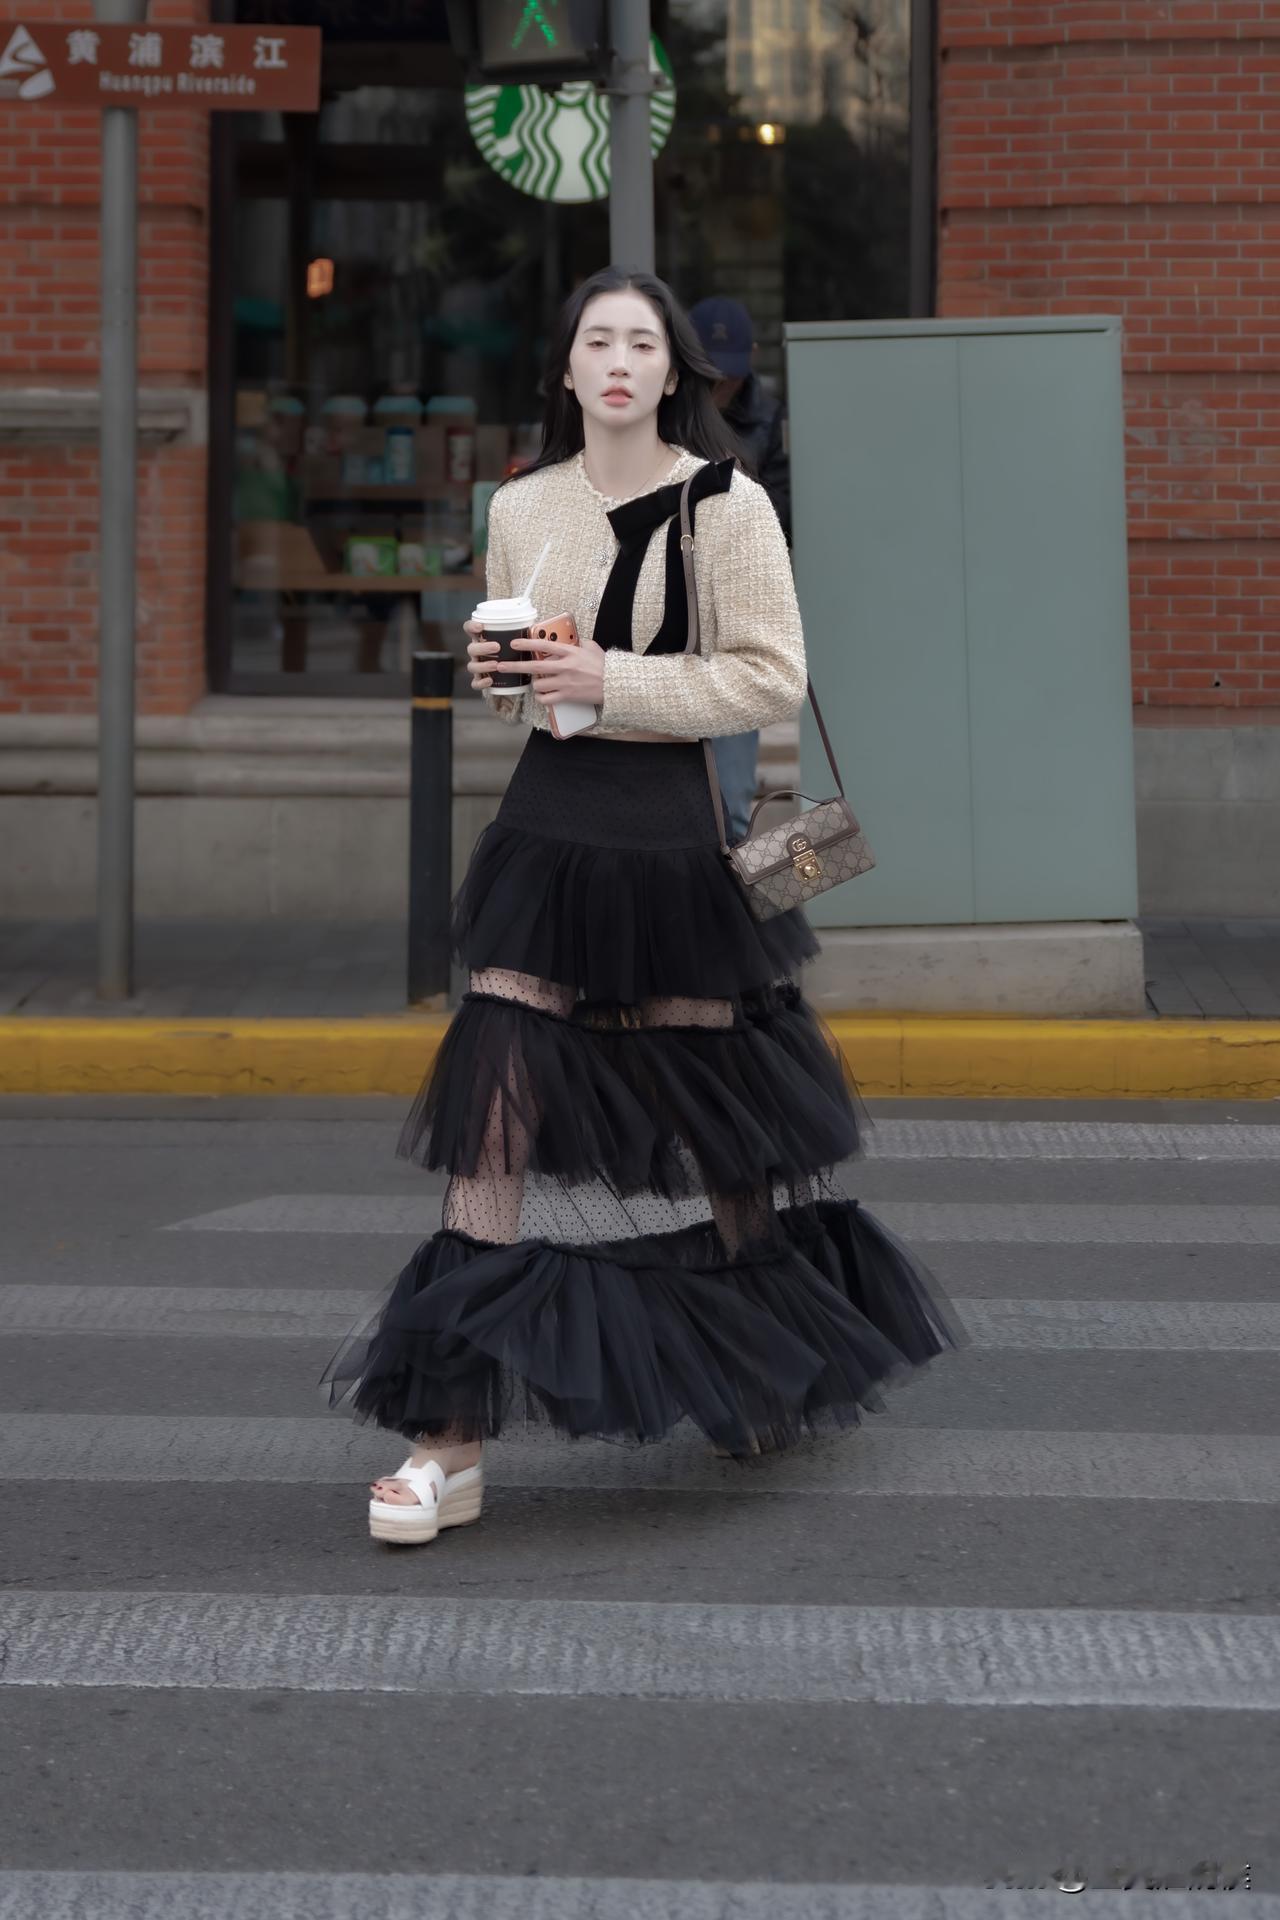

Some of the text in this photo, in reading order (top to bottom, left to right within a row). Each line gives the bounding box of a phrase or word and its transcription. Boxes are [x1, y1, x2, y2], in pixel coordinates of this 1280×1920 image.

[65, 30, 288, 69] 黄浦滨江
[177, 73, 256, 95] Riverside
